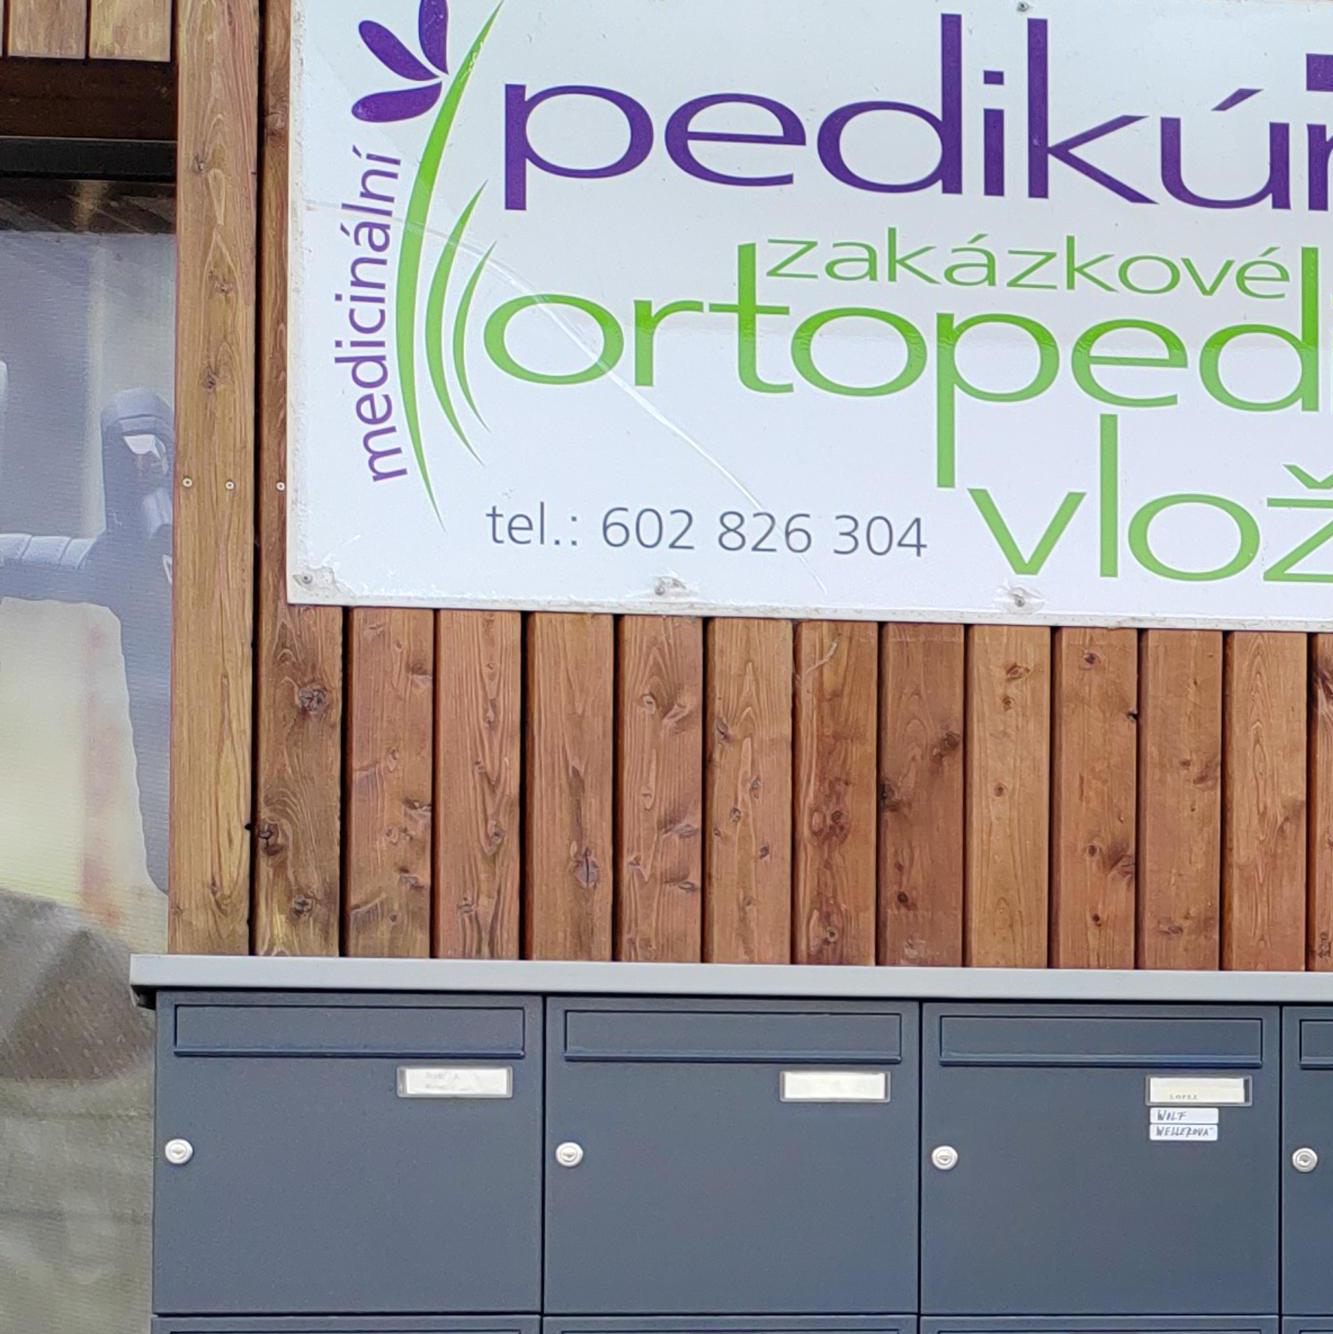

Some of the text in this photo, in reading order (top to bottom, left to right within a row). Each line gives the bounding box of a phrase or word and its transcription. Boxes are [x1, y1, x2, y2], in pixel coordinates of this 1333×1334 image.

[766, 227, 1290, 299] zakázkové
[334, 147, 408, 483] medicinální
[486, 502, 928, 557] tel.: 602 826 304
